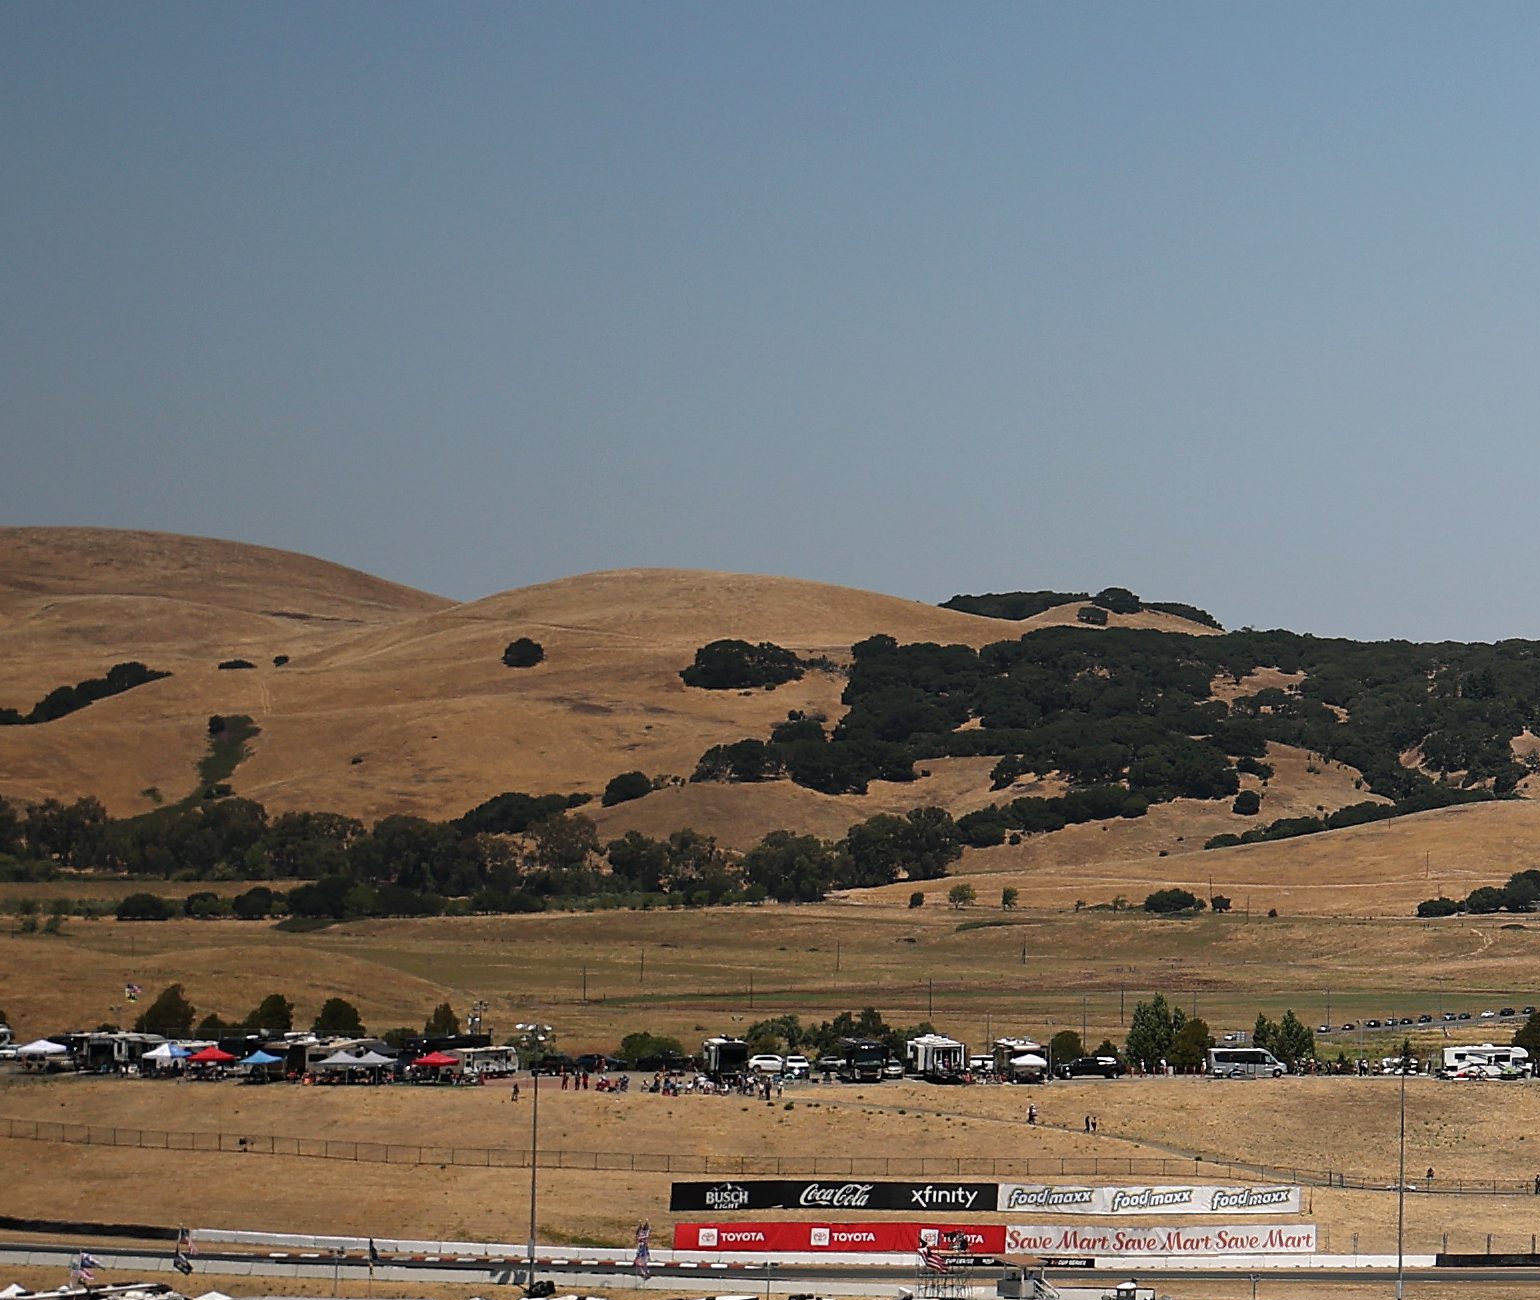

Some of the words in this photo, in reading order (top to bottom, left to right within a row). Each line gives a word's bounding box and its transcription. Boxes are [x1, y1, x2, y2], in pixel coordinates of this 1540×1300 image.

[705, 1190, 749, 1204] BUSCH
[911, 1185, 979, 1207] xfinity
[721, 1232, 765, 1242] TOYOTA
[832, 1232, 876, 1243] TOYOTA
[1007, 1230, 1052, 1250] Save
[1055, 1230, 1109, 1250] Mart
[1112, 1231, 1157, 1251] Save
[1160, 1231, 1212, 1251] Mart
[1215, 1230, 1258, 1249] Save
[1262, 1229, 1313, 1248] Mart
